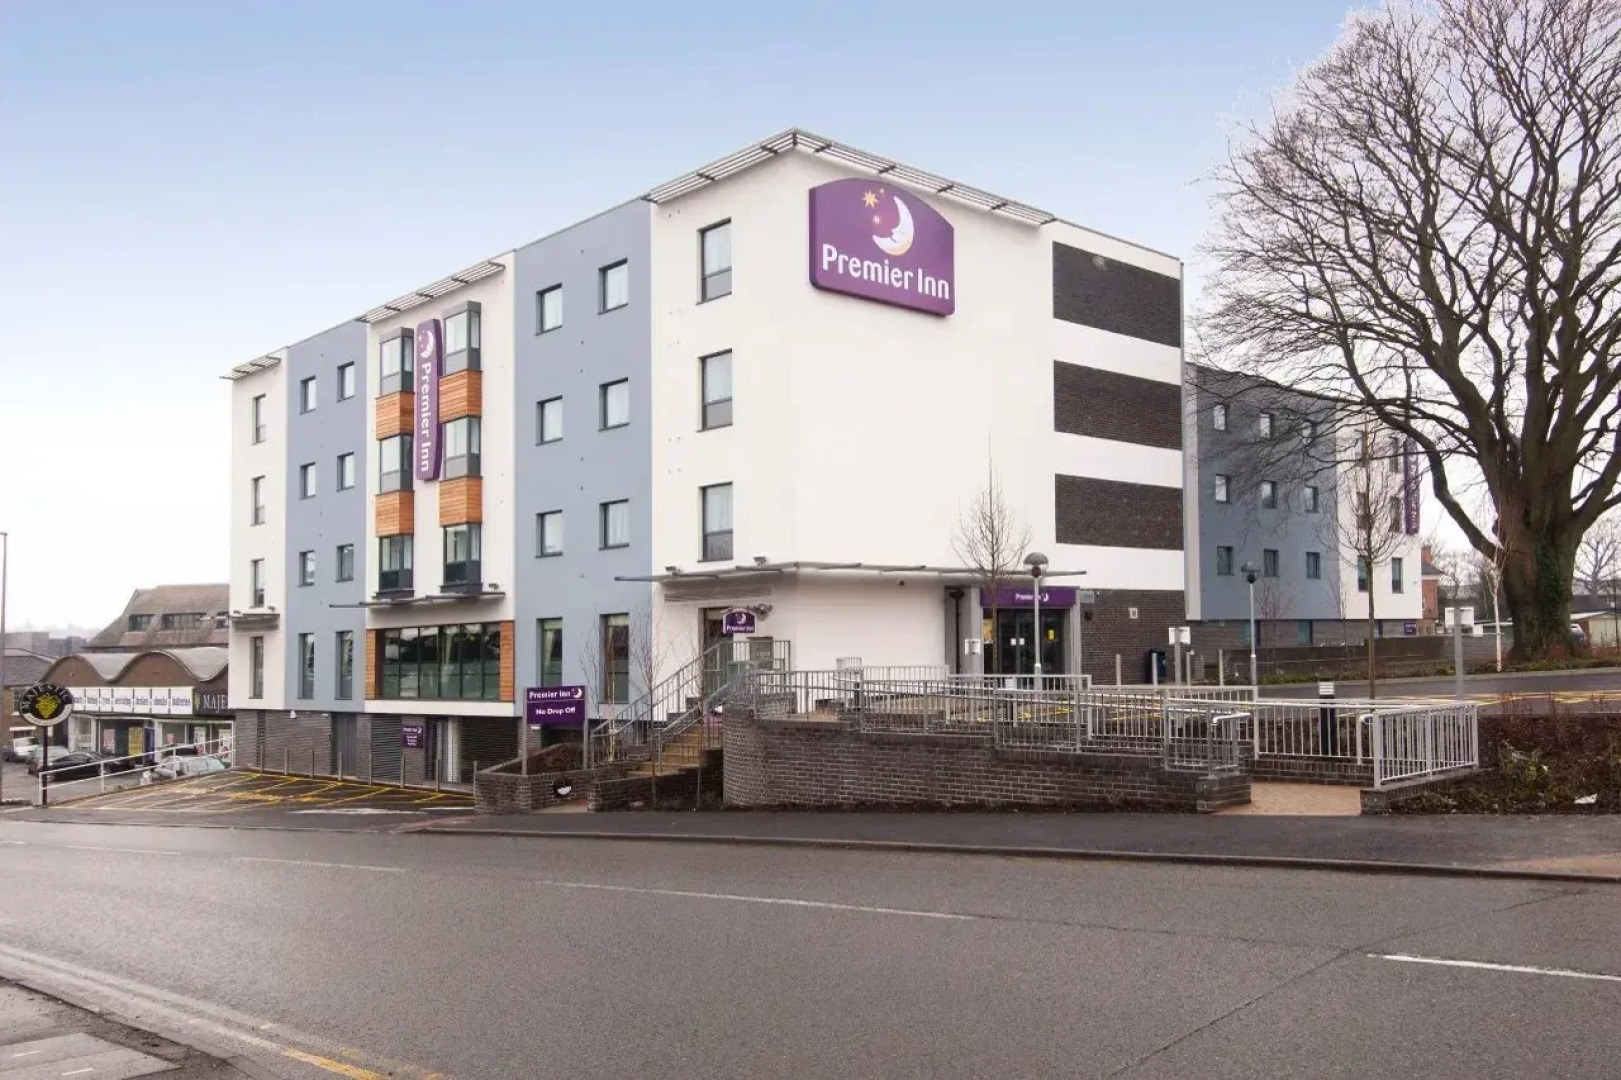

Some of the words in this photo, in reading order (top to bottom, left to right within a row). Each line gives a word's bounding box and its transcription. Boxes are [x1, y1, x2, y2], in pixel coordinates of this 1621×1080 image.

[822, 243, 914, 290] Premier
[917, 267, 950, 300] Inn
[420, 362, 431, 438] Premier
[420, 441, 431, 472] Inn
[528, 690, 557, 700] Premier
[559, 689, 571, 698] Inn
[547, 708, 564, 716] Drop
[565, 706, 576, 714] Off
